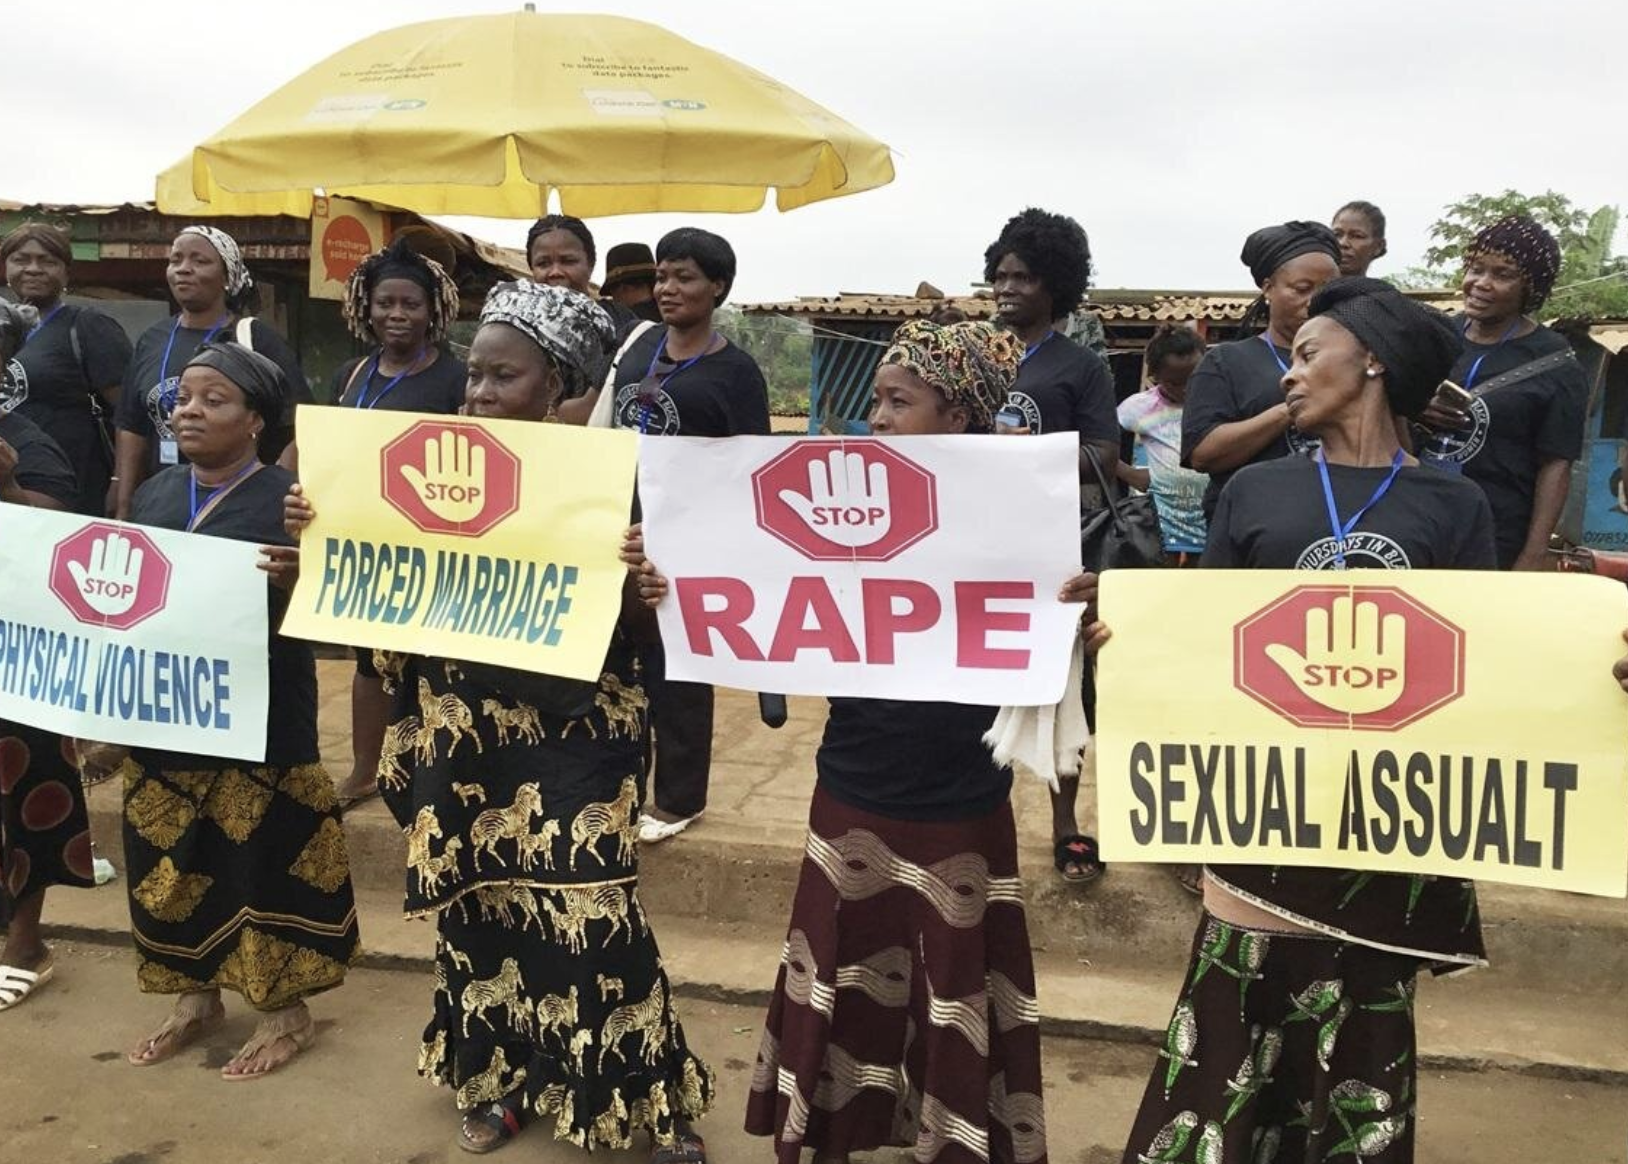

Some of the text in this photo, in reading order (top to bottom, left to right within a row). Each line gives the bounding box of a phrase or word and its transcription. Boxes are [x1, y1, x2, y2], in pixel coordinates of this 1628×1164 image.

[425, 482, 480, 504] STOP
[812, 506, 885, 527] STOP
[1301, 537, 1364, 570] HURSDAYS
[1366, 538, 1387, 554] IN
[83, 577, 134, 600] STOP
[315, 537, 578, 647] FORCED MARRIAGE
[675, 576, 1034, 669] RAPE
[94, 642, 231, 730] VIOLENCE
[1303, 664, 1398, 690] STOP
[1129, 741, 1578, 870] SEXUAL ASSUALT
